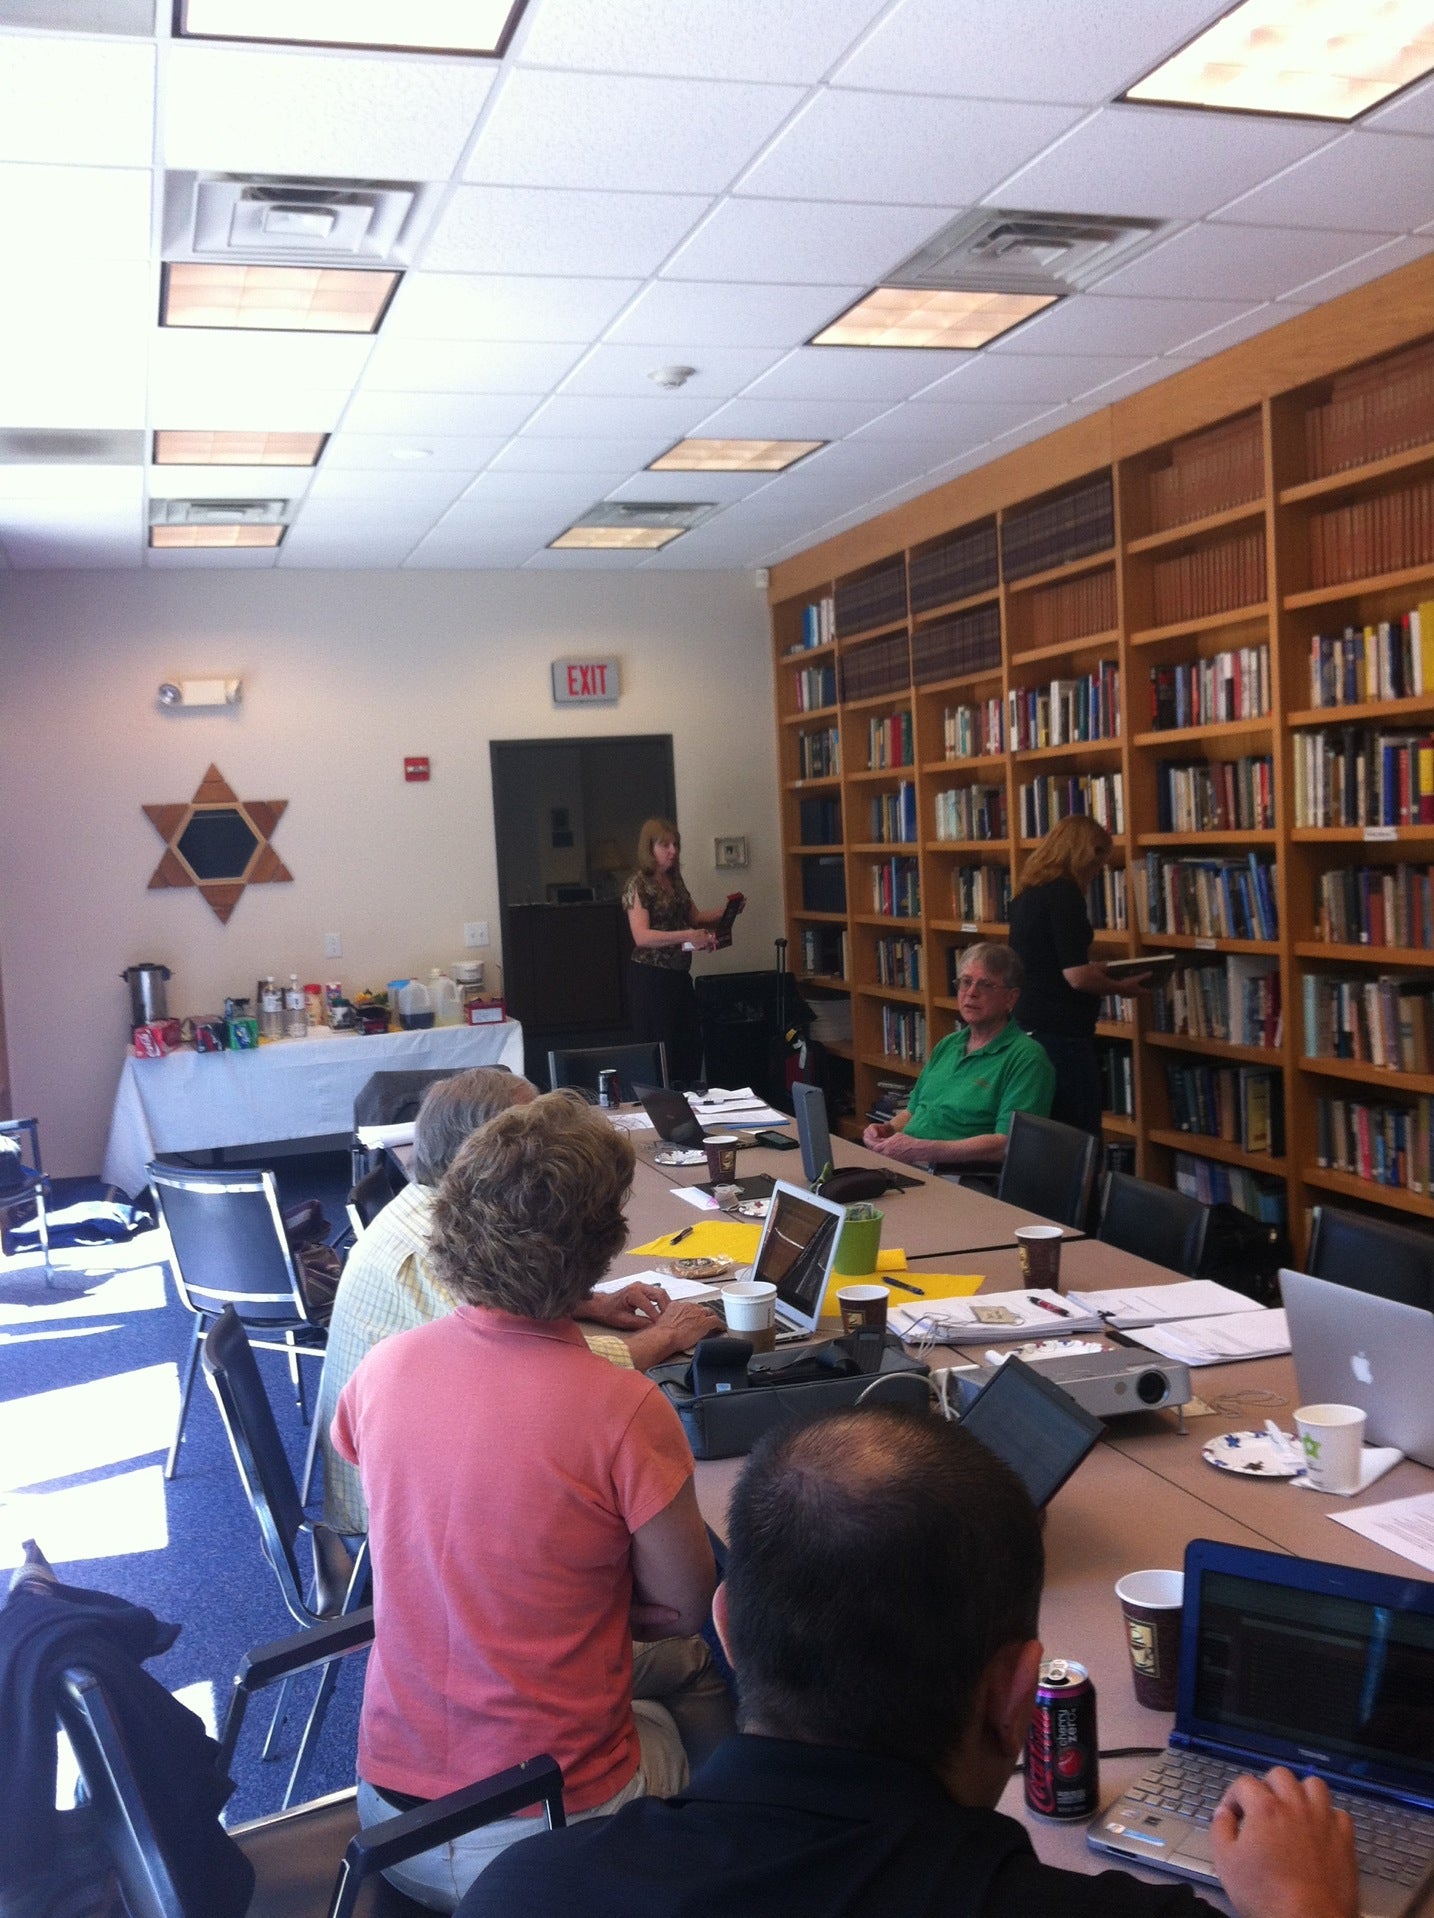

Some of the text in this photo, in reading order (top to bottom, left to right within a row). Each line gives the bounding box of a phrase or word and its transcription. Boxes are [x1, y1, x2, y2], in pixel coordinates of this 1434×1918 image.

[567, 664, 607, 696] EXIT
[1057, 1709, 1069, 1746] cherry
[1067, 1713, 1078, 1743] zero
